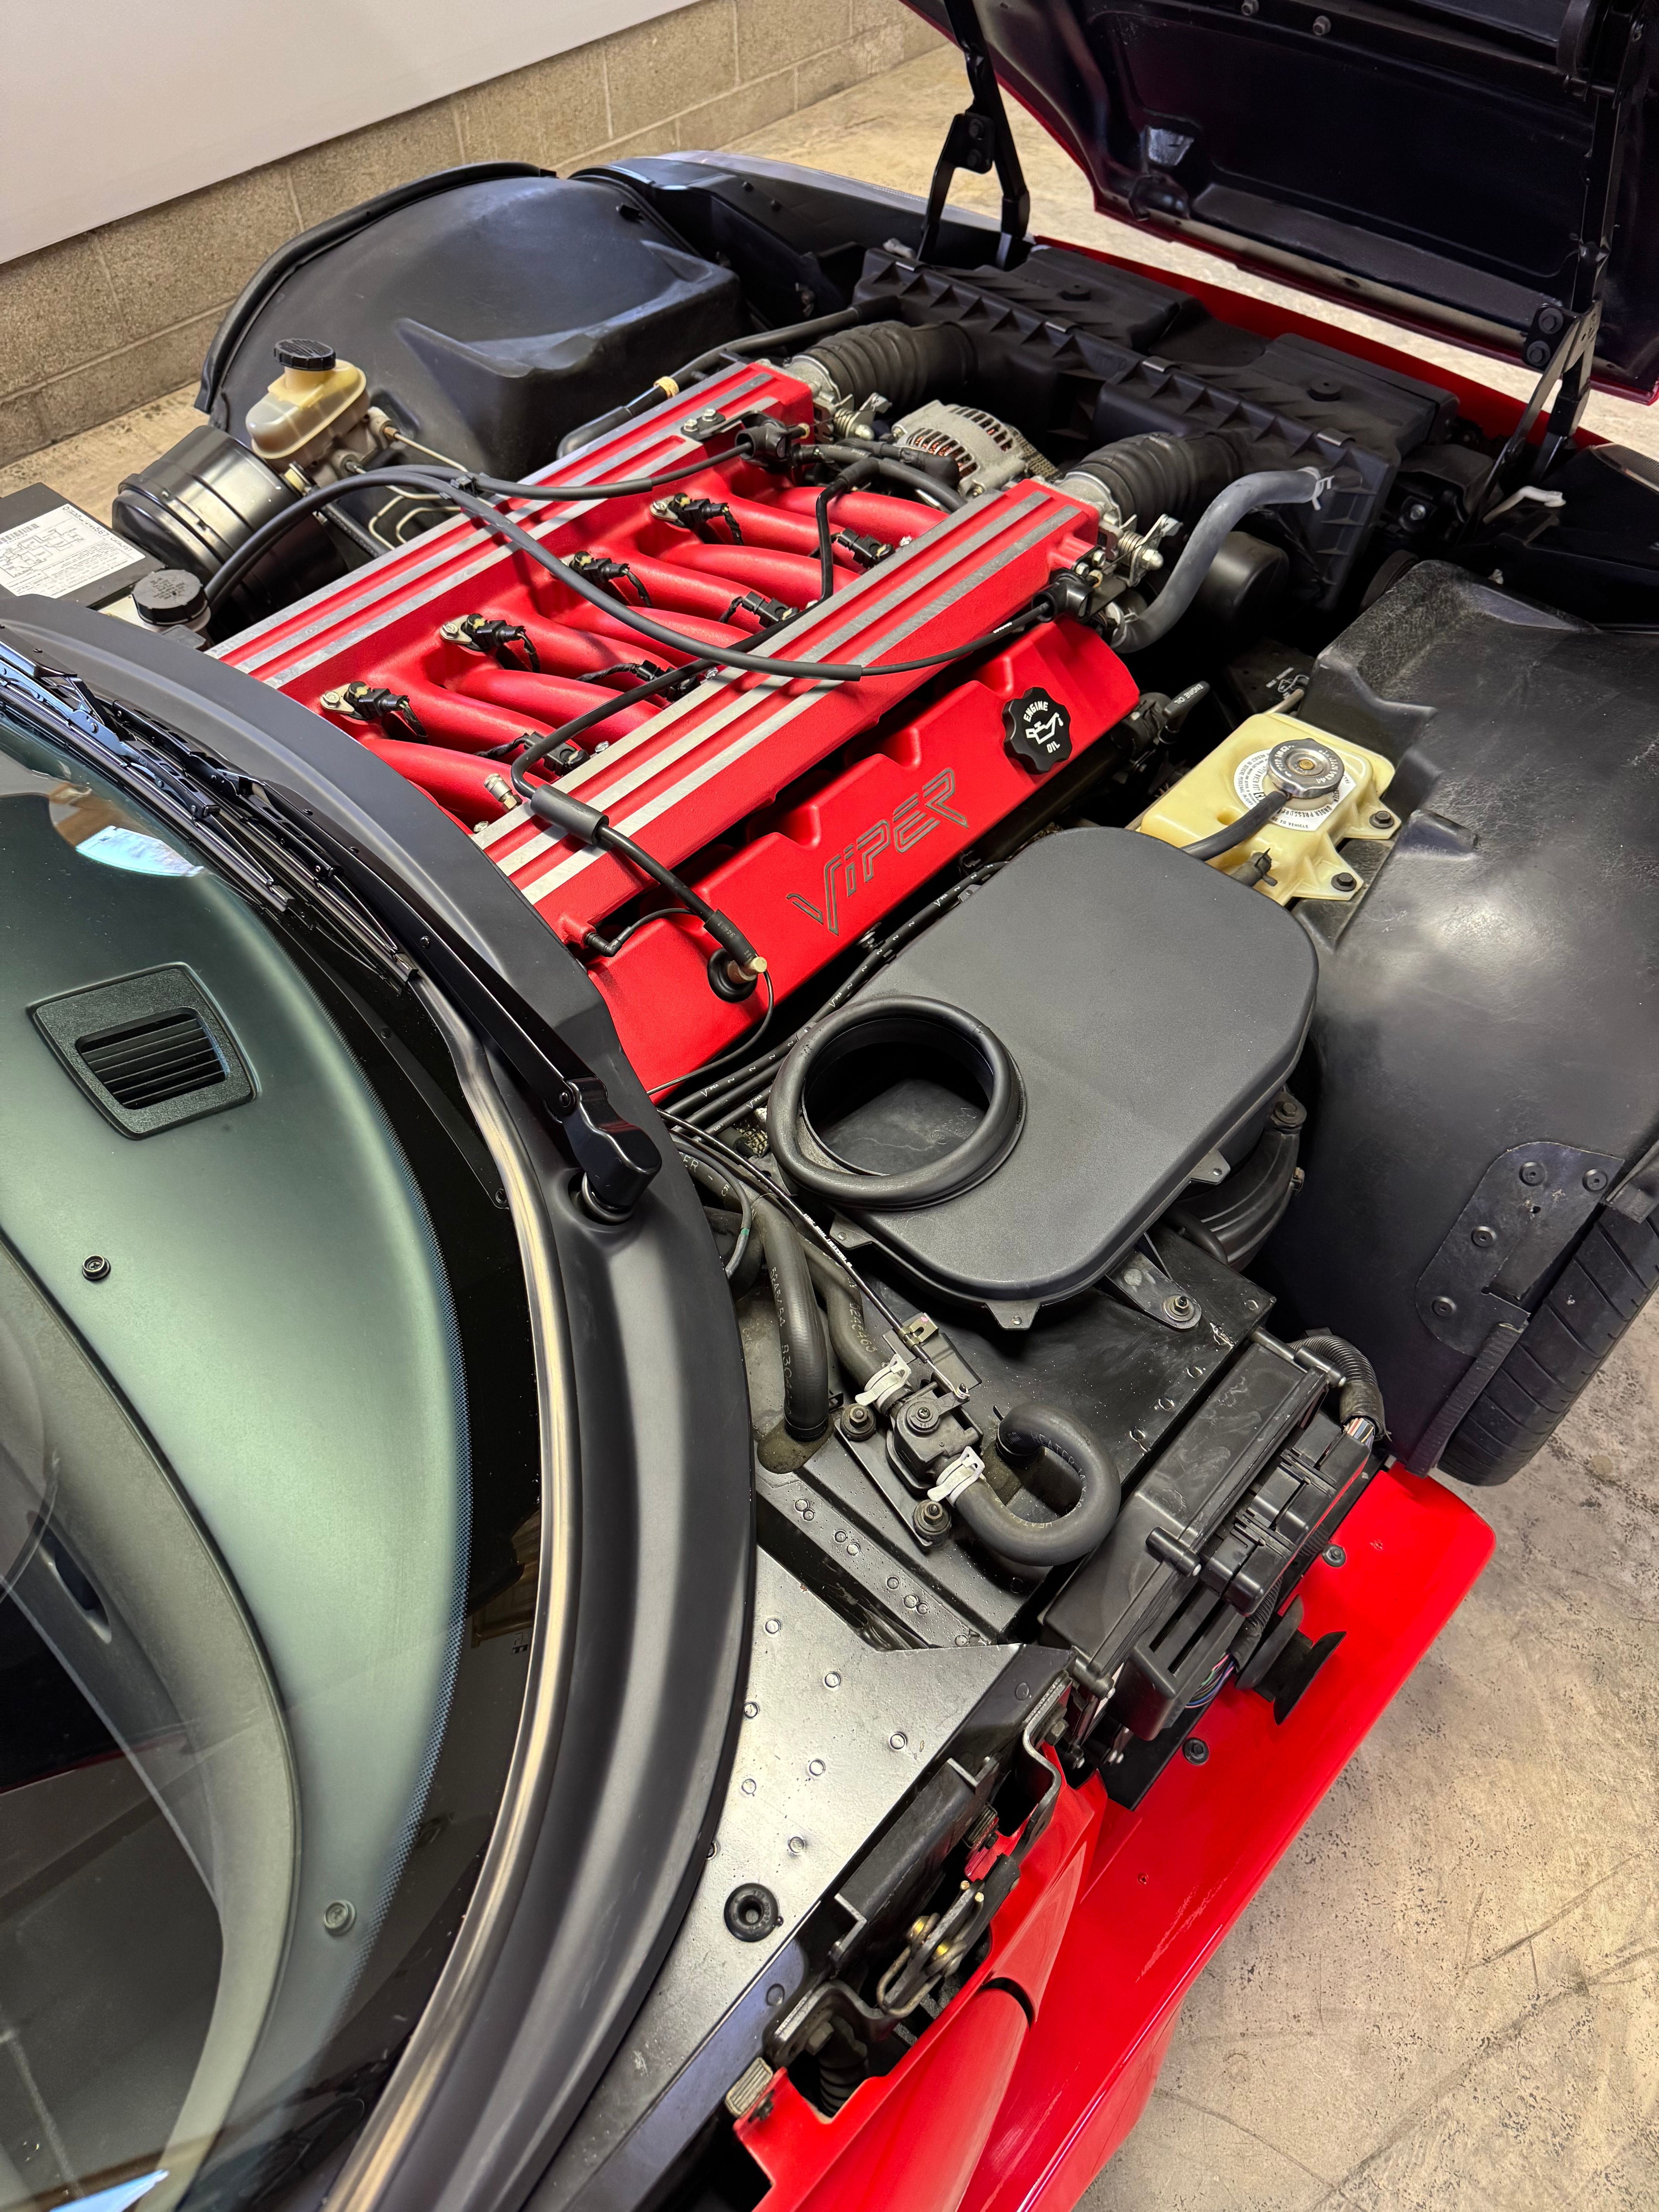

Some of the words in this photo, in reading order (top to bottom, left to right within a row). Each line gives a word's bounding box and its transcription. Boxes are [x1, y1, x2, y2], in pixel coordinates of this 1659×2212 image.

[1173, 696, 1185, 705] OIL
[1183, 684, 1204, 699] ENGINE
[1023, 701, 1049, 722] ENGINE
[1046, 741, 1061, 753] OIL
[787, 768, 969, 936] VIPER
[1030, 1431, 1075, 1465] HEATER
